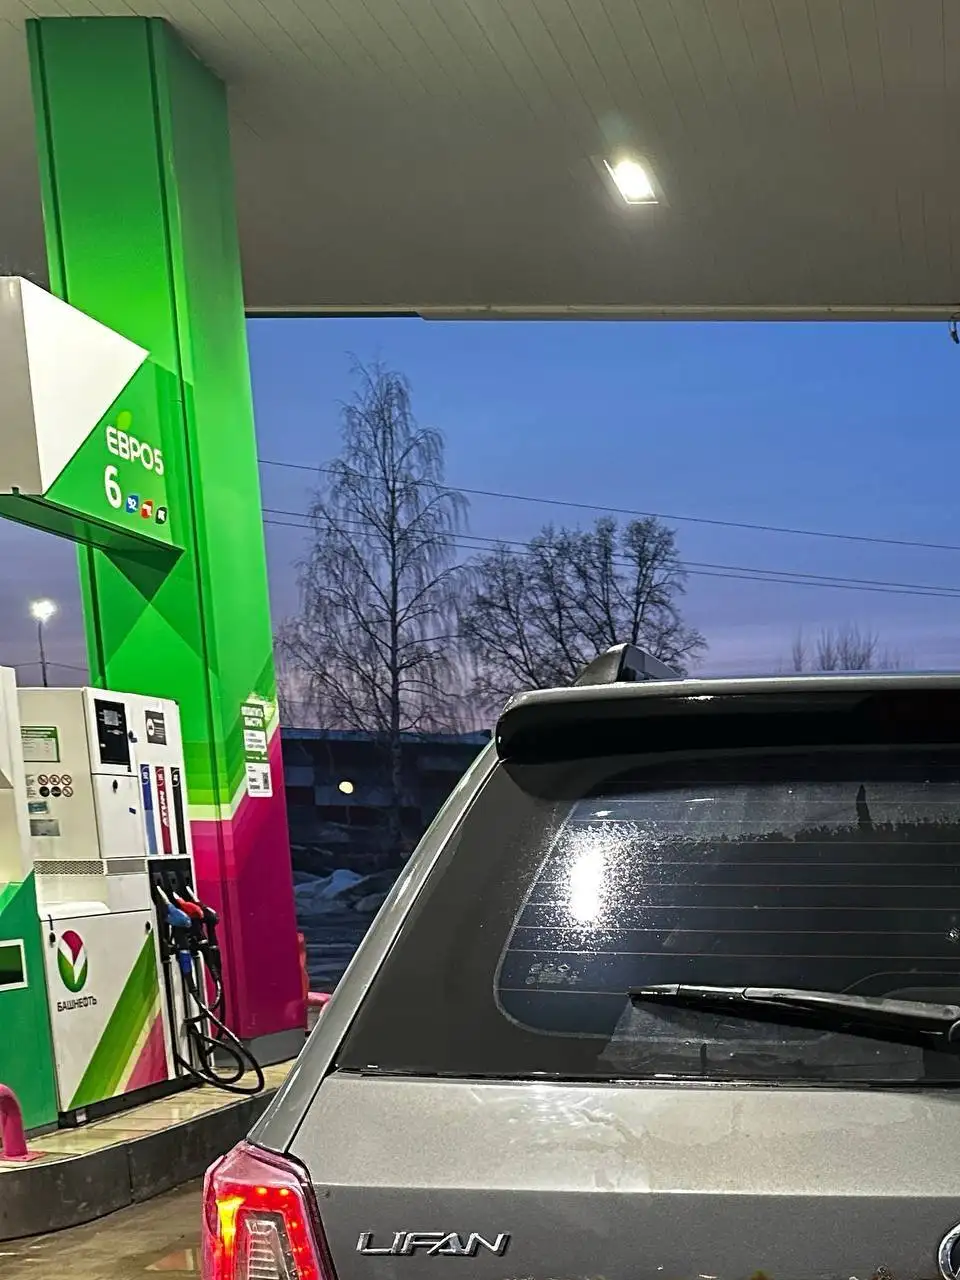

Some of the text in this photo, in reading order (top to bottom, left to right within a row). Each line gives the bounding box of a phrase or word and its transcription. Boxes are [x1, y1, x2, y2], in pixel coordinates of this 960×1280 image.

[105, 465, 122, 509] 6
[57, 995, 98, 1012] БАШНЕФТЬ
[356, 1231, 511, 1256] LIFAN
